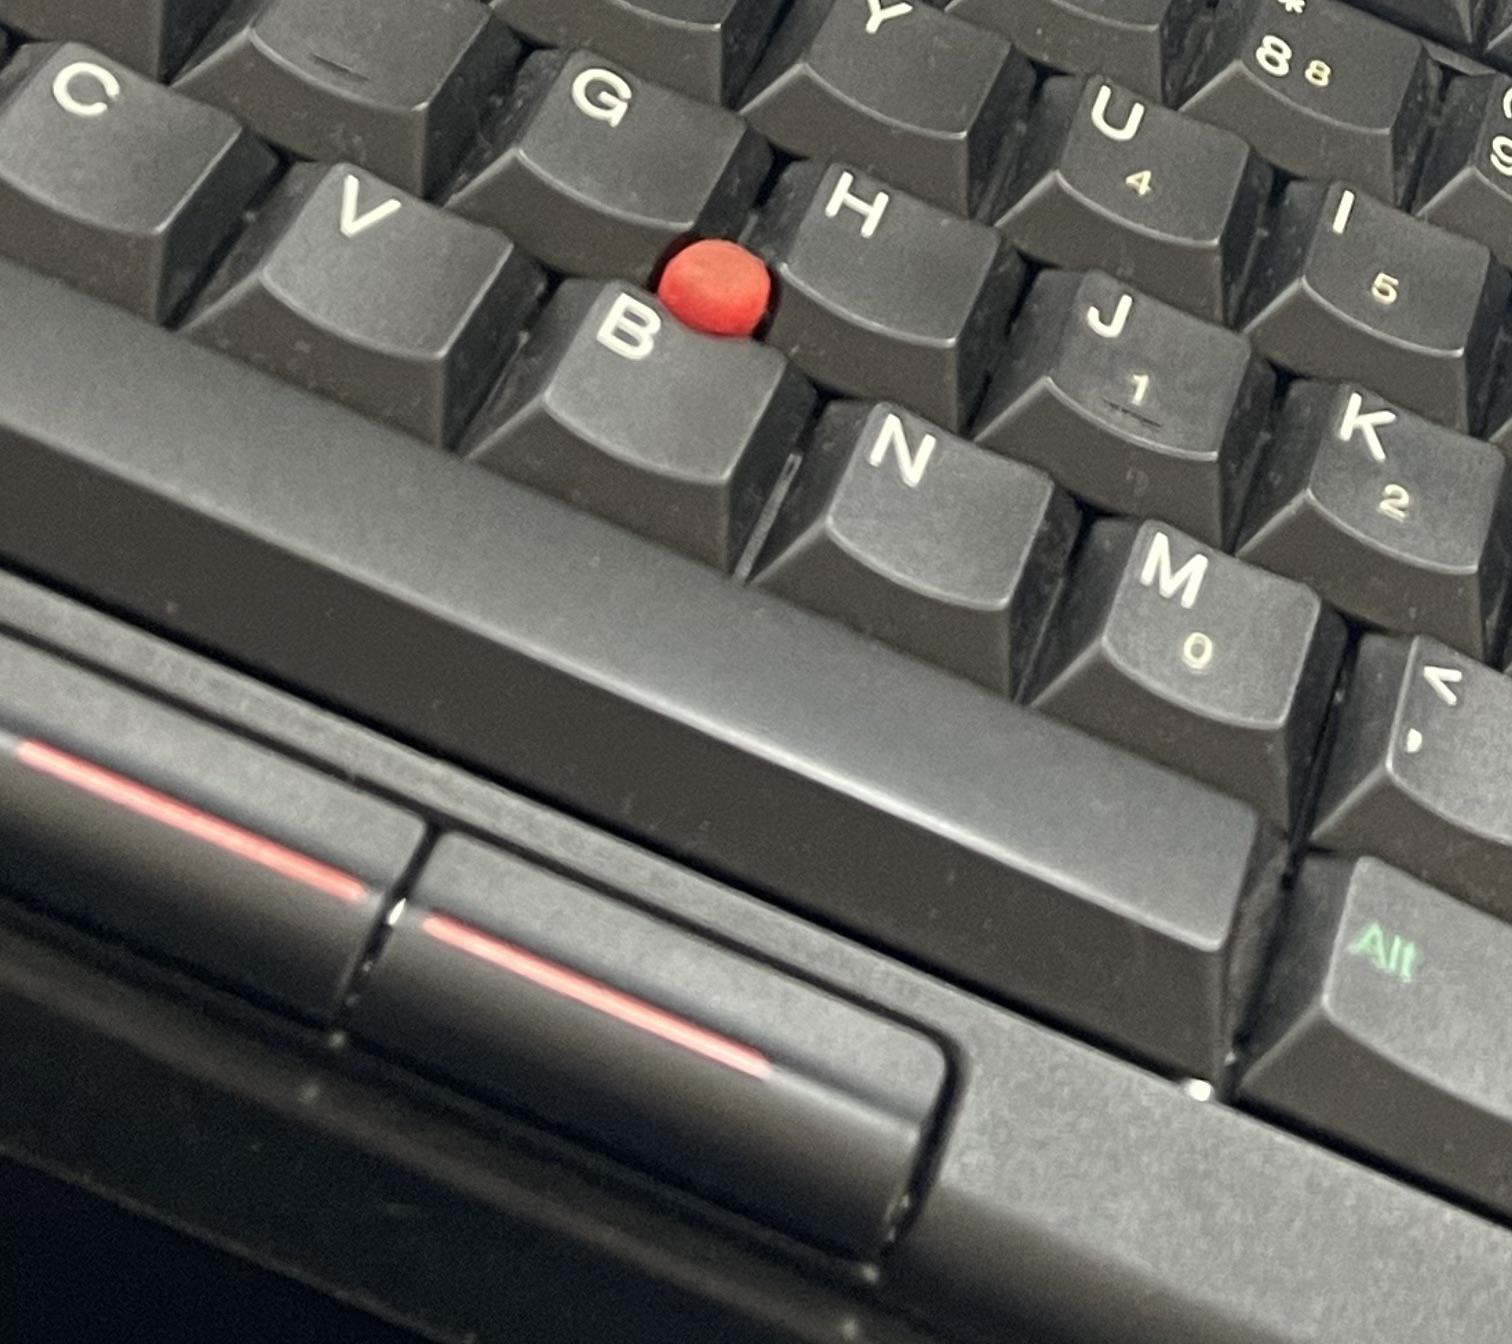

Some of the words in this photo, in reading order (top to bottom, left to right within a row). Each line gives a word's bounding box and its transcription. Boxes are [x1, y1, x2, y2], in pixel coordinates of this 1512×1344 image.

[1255, 35, 1292, 76] 8
[1304, 59, 1331, 87] 8
[52, 62, 120, 116] C
[572, 68, 632, 128] G
[1091, 85, 1145, 141] U
[340, 174, 402, 238] V
[825, 171, 889, 238] H
[1125, 170, 1152, 196] 4
[1332, 190, 1355, 234] I
[1086, 294, 1133, 338] J
[1371, 272, 1399, 305] 5
[596, 292, 661, 360] B
[1131, 374, 1149, 406] 1
[869, 413, 936, 488] N
[1338, 392, 1396, 462] K
[1379, 484, 1410, 522] 2
[1140, 532, 1209, 609] M
[1423, 666, 1463, 705] <
[1346, 918, 1420, 985] Alt
